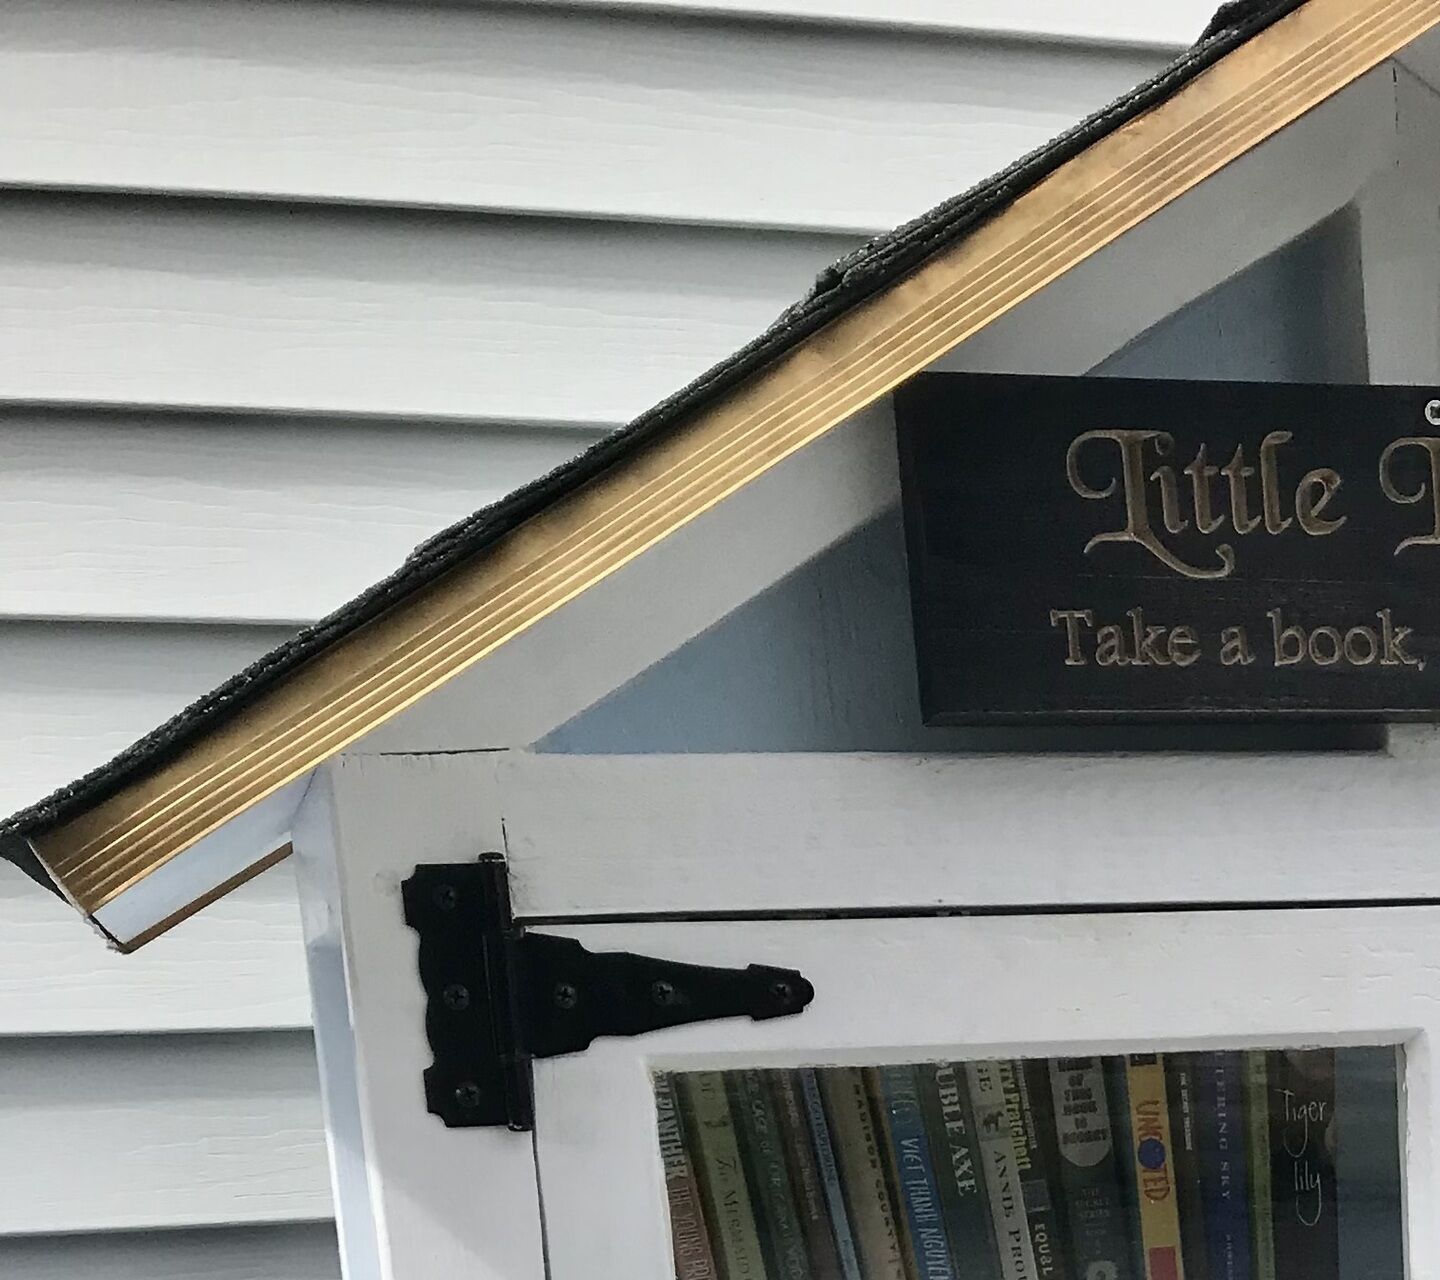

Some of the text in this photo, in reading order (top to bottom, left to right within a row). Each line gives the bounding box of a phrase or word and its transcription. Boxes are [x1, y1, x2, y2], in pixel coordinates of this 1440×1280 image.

[1066, 429, 1347, 579] Little
[1050, 606, 1200, 667] Take
[1220, 624, 1256, 666] a
[1266, 606, 1426, 671] book,
[1273, 1088, 1328, 1158] Tiger
[900, 1137, 926, 1173] VIET
[949, 1143, 978, 1197] AXE
[669, 1184, 692, 1211] THE
[905, 1177, 939, 1223] THANH
